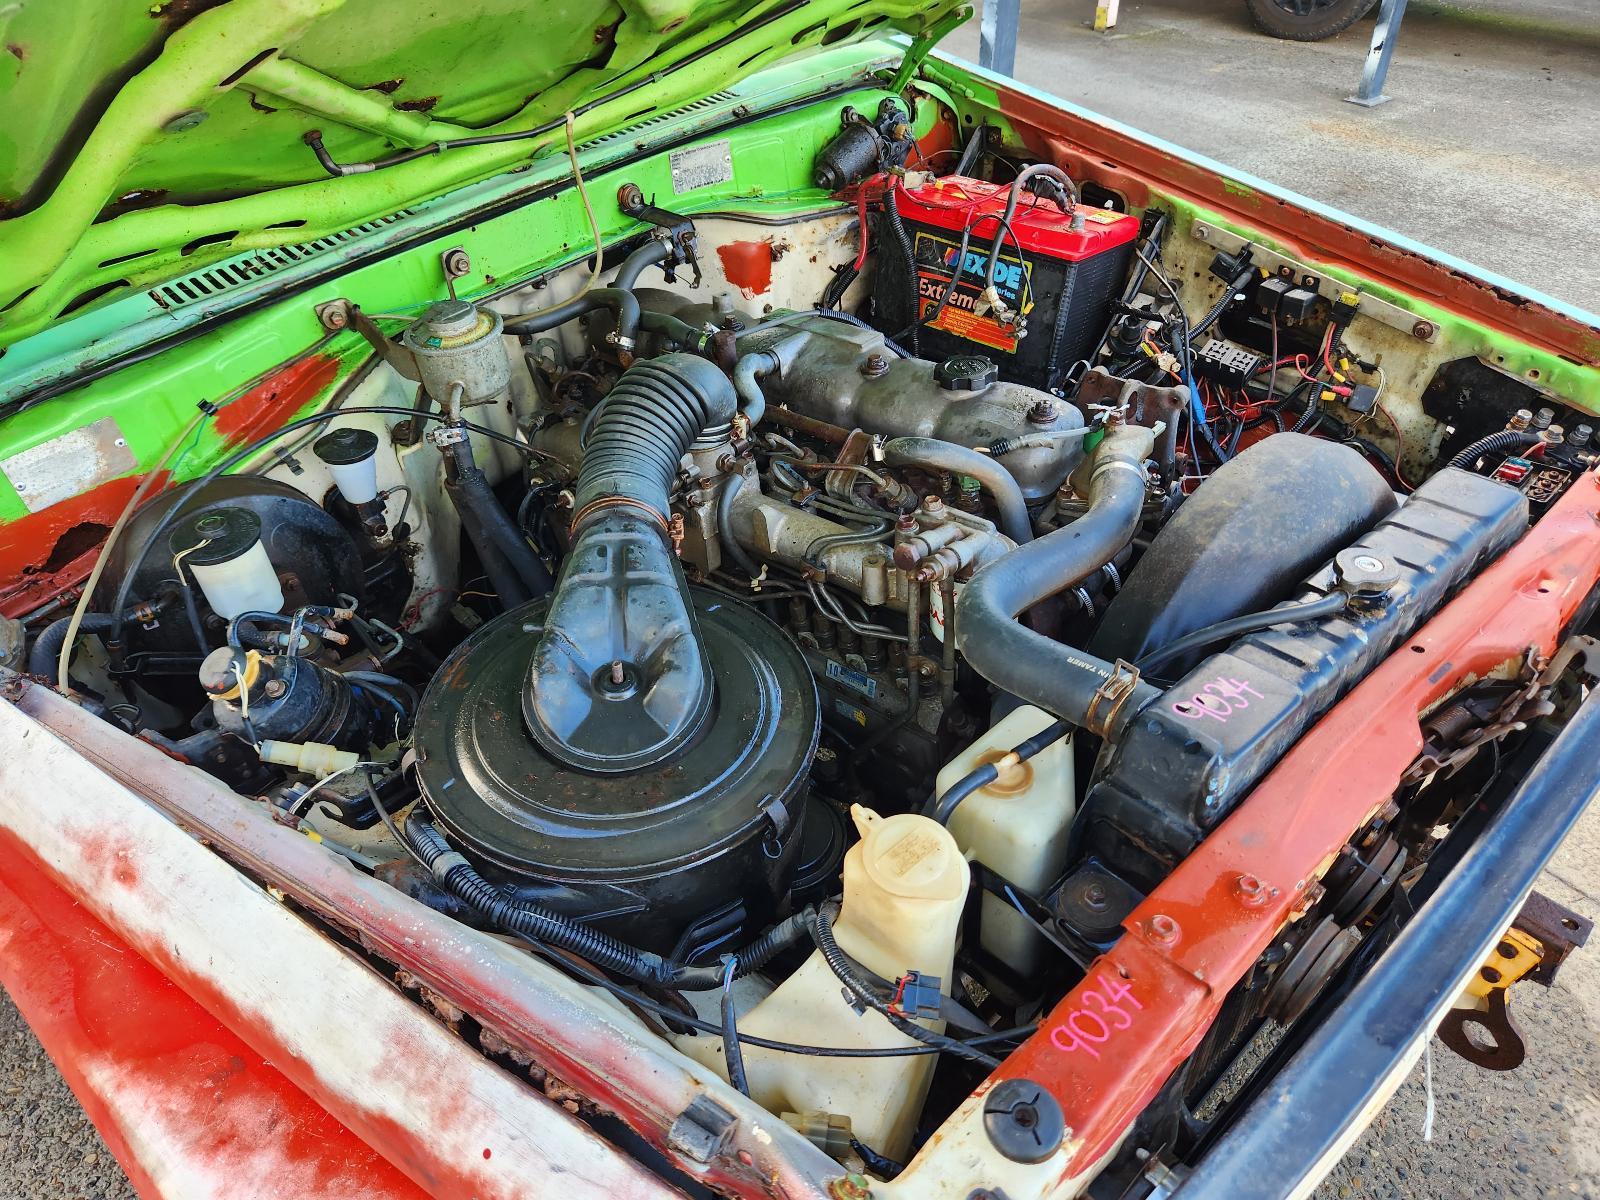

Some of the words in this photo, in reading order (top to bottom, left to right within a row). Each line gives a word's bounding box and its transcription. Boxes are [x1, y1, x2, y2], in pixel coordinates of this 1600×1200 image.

[963, 252, 1022, 290] EXDE
[1172, 677, 1264, 722] 9034
[1051, 975, 1144, 1061] 9034
